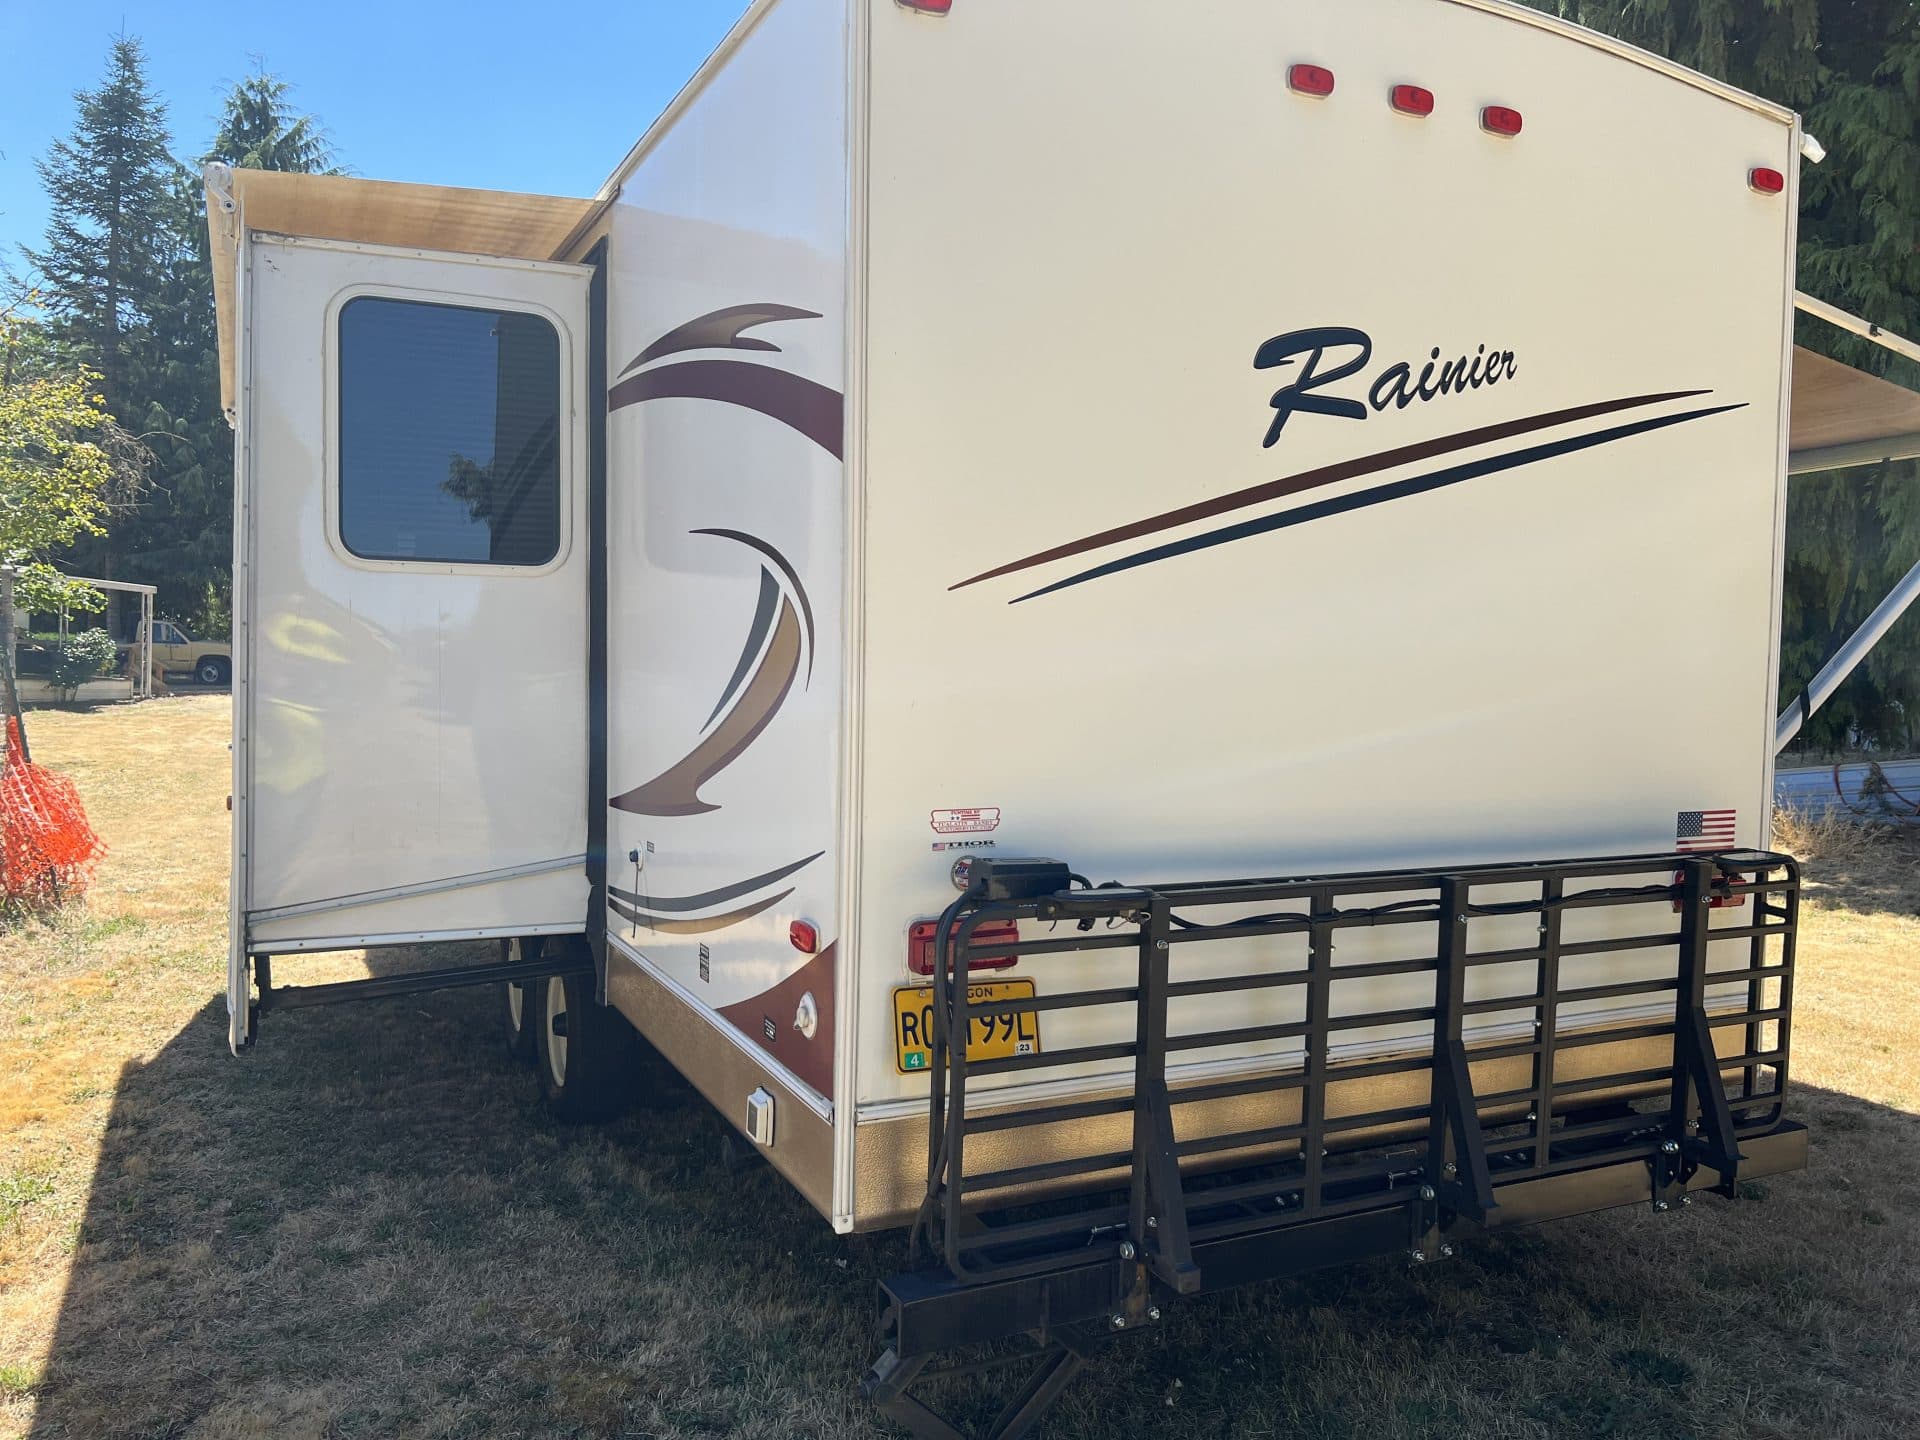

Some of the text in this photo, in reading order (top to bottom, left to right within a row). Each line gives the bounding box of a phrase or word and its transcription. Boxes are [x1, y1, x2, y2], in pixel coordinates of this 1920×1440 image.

[1253, 327, 1518, 449] Rainier
[967, 986, 993, 999] GON
[1019, 1043, 1030, 1052] 23
[910, 1053, 920, 1067] 4
